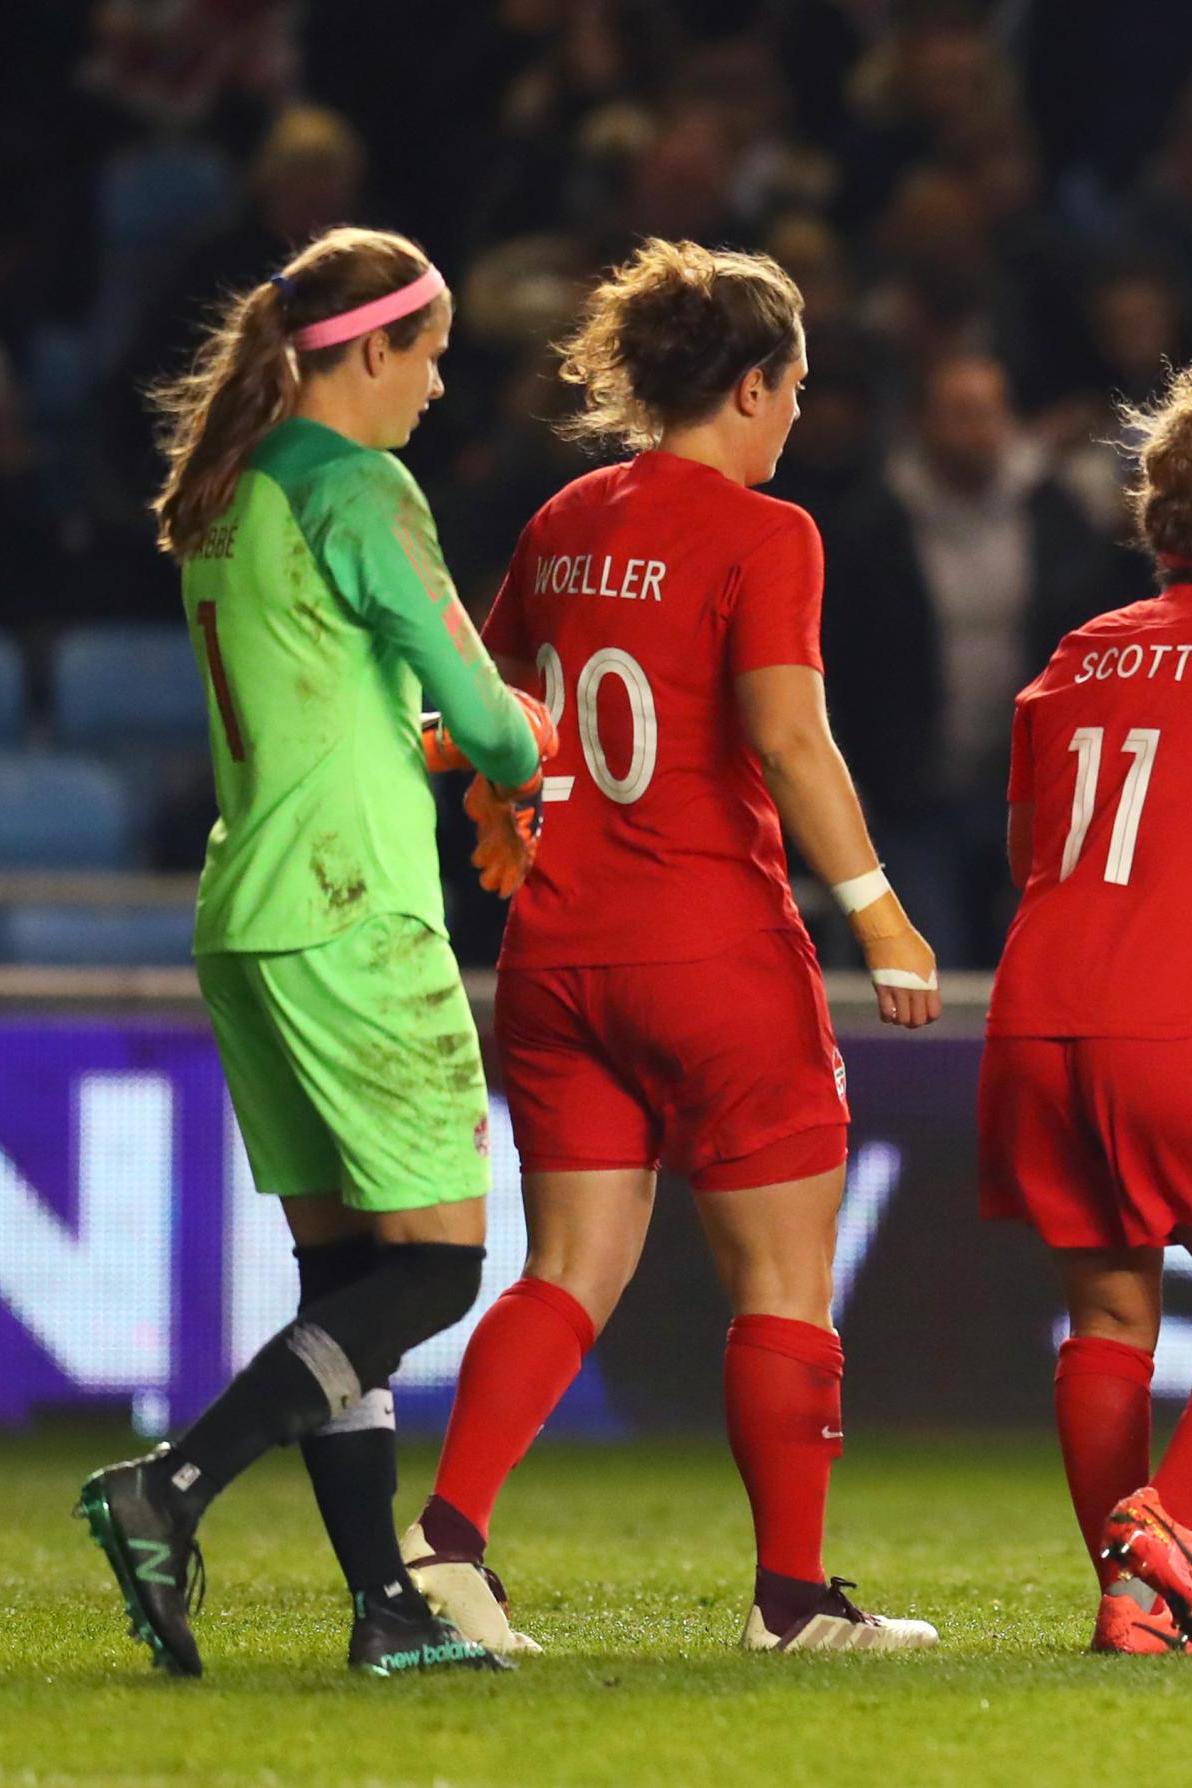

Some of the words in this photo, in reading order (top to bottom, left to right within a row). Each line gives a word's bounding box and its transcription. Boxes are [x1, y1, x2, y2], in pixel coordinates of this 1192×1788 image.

[534, 555, 667, 601] WOELLER
[197, 600, 245, 762] 1
[536, 642, 658, 805] 20
[1059, 727, 1161, 886] 11
